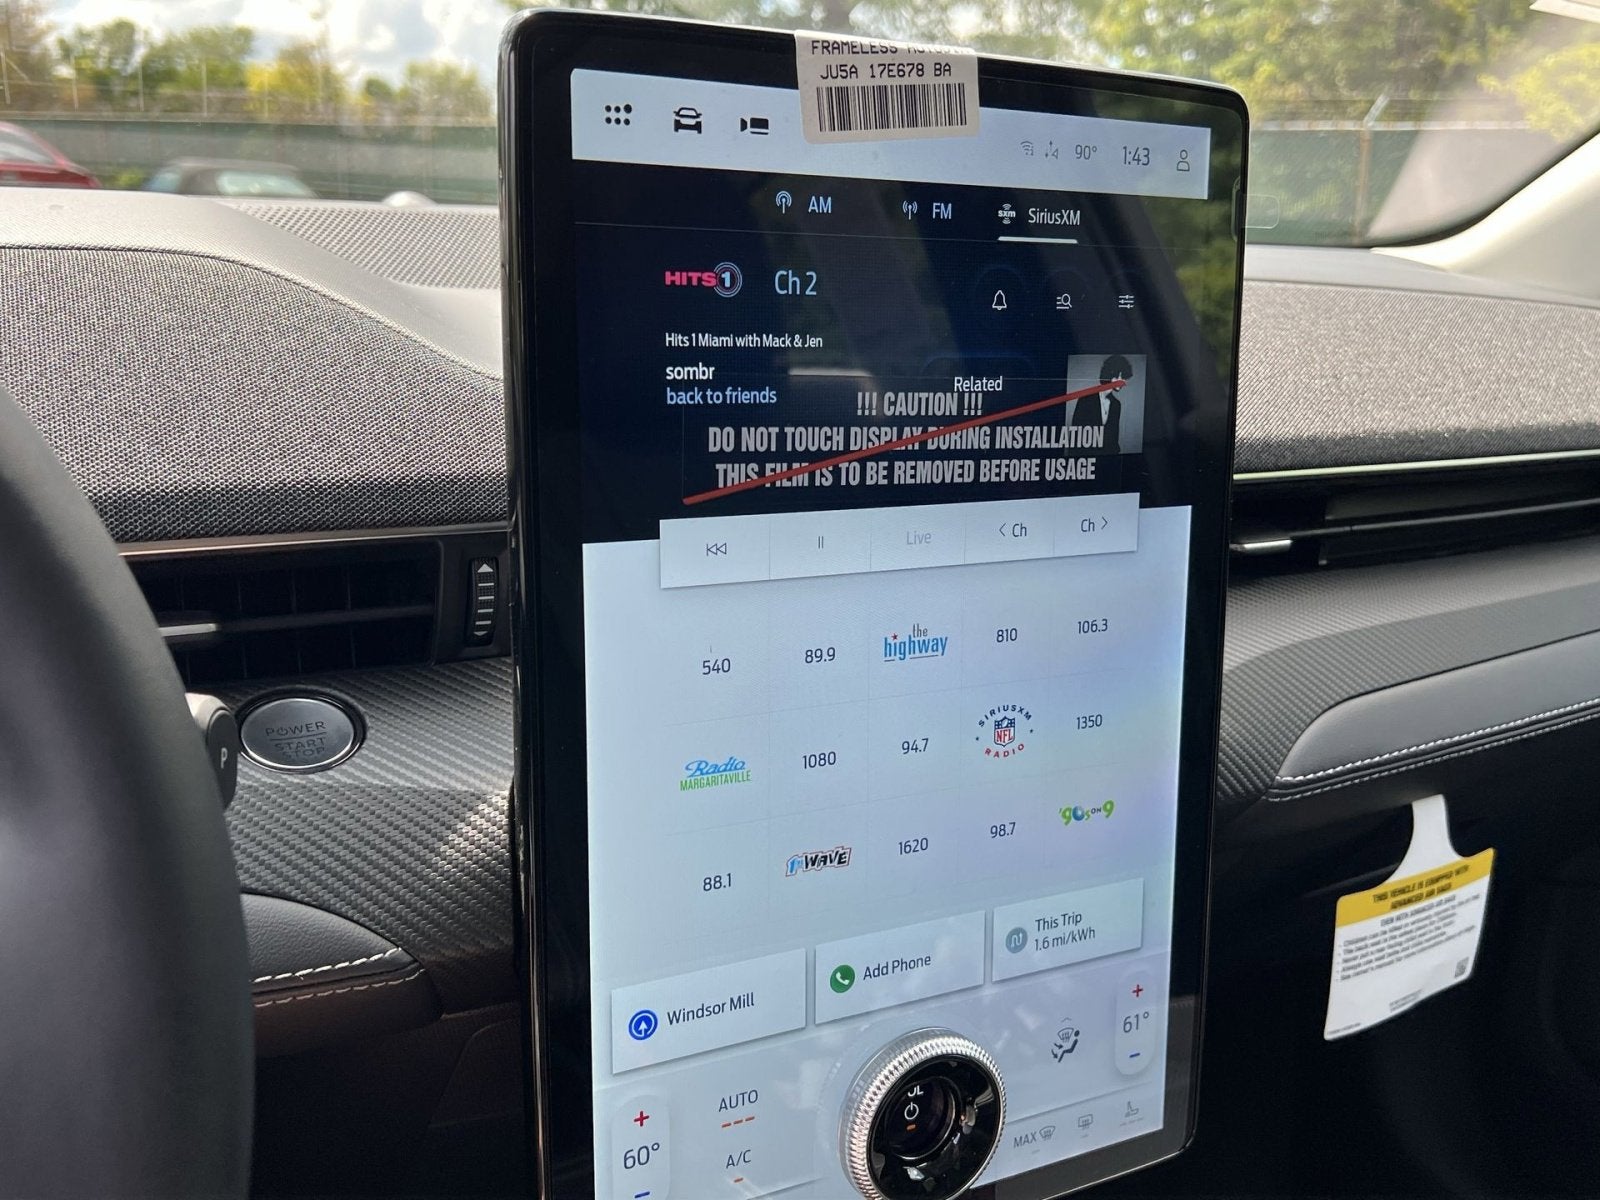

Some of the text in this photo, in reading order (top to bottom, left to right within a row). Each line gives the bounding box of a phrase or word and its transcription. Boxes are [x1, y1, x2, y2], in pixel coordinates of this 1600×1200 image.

[811, 40, 898, 55] FRAMELESS
[820, 62, 952, 80] JU5A 17E678 BA
[1123, 146, 1150, 166] 1:43
[808, 196, 832, 214] AM
[932, 203, 952, 219] FM
[1028, 208, 1081, 226] SiriusXM
[774, 270, 817, 295] Ch 2
[665, 333, 823, 348] Hits 1 Miami with Mack & Jen
[665, 362, 716, 380] sombr
[953, 376, 1003, 392] Related
[666, 386, 777, 405] back to friends
[883, 391, 958, 416] CAUTION
[708, 425, 1104, 452] DO NOT TOUCH DISPLAY DURING INSTALLATION
[715, 463, 760, 488] THIS
[815, 464, 834, 486] IS
[839, 462, 861, 486] TO
[866, 461, 889, 485] BE
[893, 459, 975, 485] REMOVED
[979, 458, 1040, 483] BEFORE
[1045, 457, 1097, 481] USAGE
[1012, 523, 1027, 538] Ch
[1081, 517, 1095, 533] Ch
[906, 530, 932, 546] Live
[912, 623, 928, 638] the
[996, 628, 1018, 643] 810
[1077, 618, 1108, 635] 106.3
[805, 647, 836, 664] 89.9
[884, 636, 948, 660] highway
[702, 658, 731, 676] 540
[1076, 714, 1103, 730] 1350
[274, 736, 327, 752] START
[996, 728, 1014, 744] NFL
[282, 747, 326, 761] STOP
[901, 738, 929, 754] 94.7
[984, 742, 1025, 759] RADIO
[220, 747, 229, 769] P
[685, 756, 746, 778] Radio
[802, 751, 837, 770] 1080
[680, 770, 751, 791] MARGARITAVILLE
[990, 822, 1016, 838] 98.7
[898, 838, 929, 856] 1620
[703, 873, 732, 892] 88.1
[1035, 912, 1082, 932] This Trip
[1034, 927, 1096, 951] 1.6 mi/kWh
[862, 954, 931, 980] Add Phone
[667, 992, 755, 1026] Windsor Mill
[718, 1089, 759, 1113] AUTO
[1013, 1131, 1037, 1148] MAX
[725, 1149, 752, 1169] A/C
